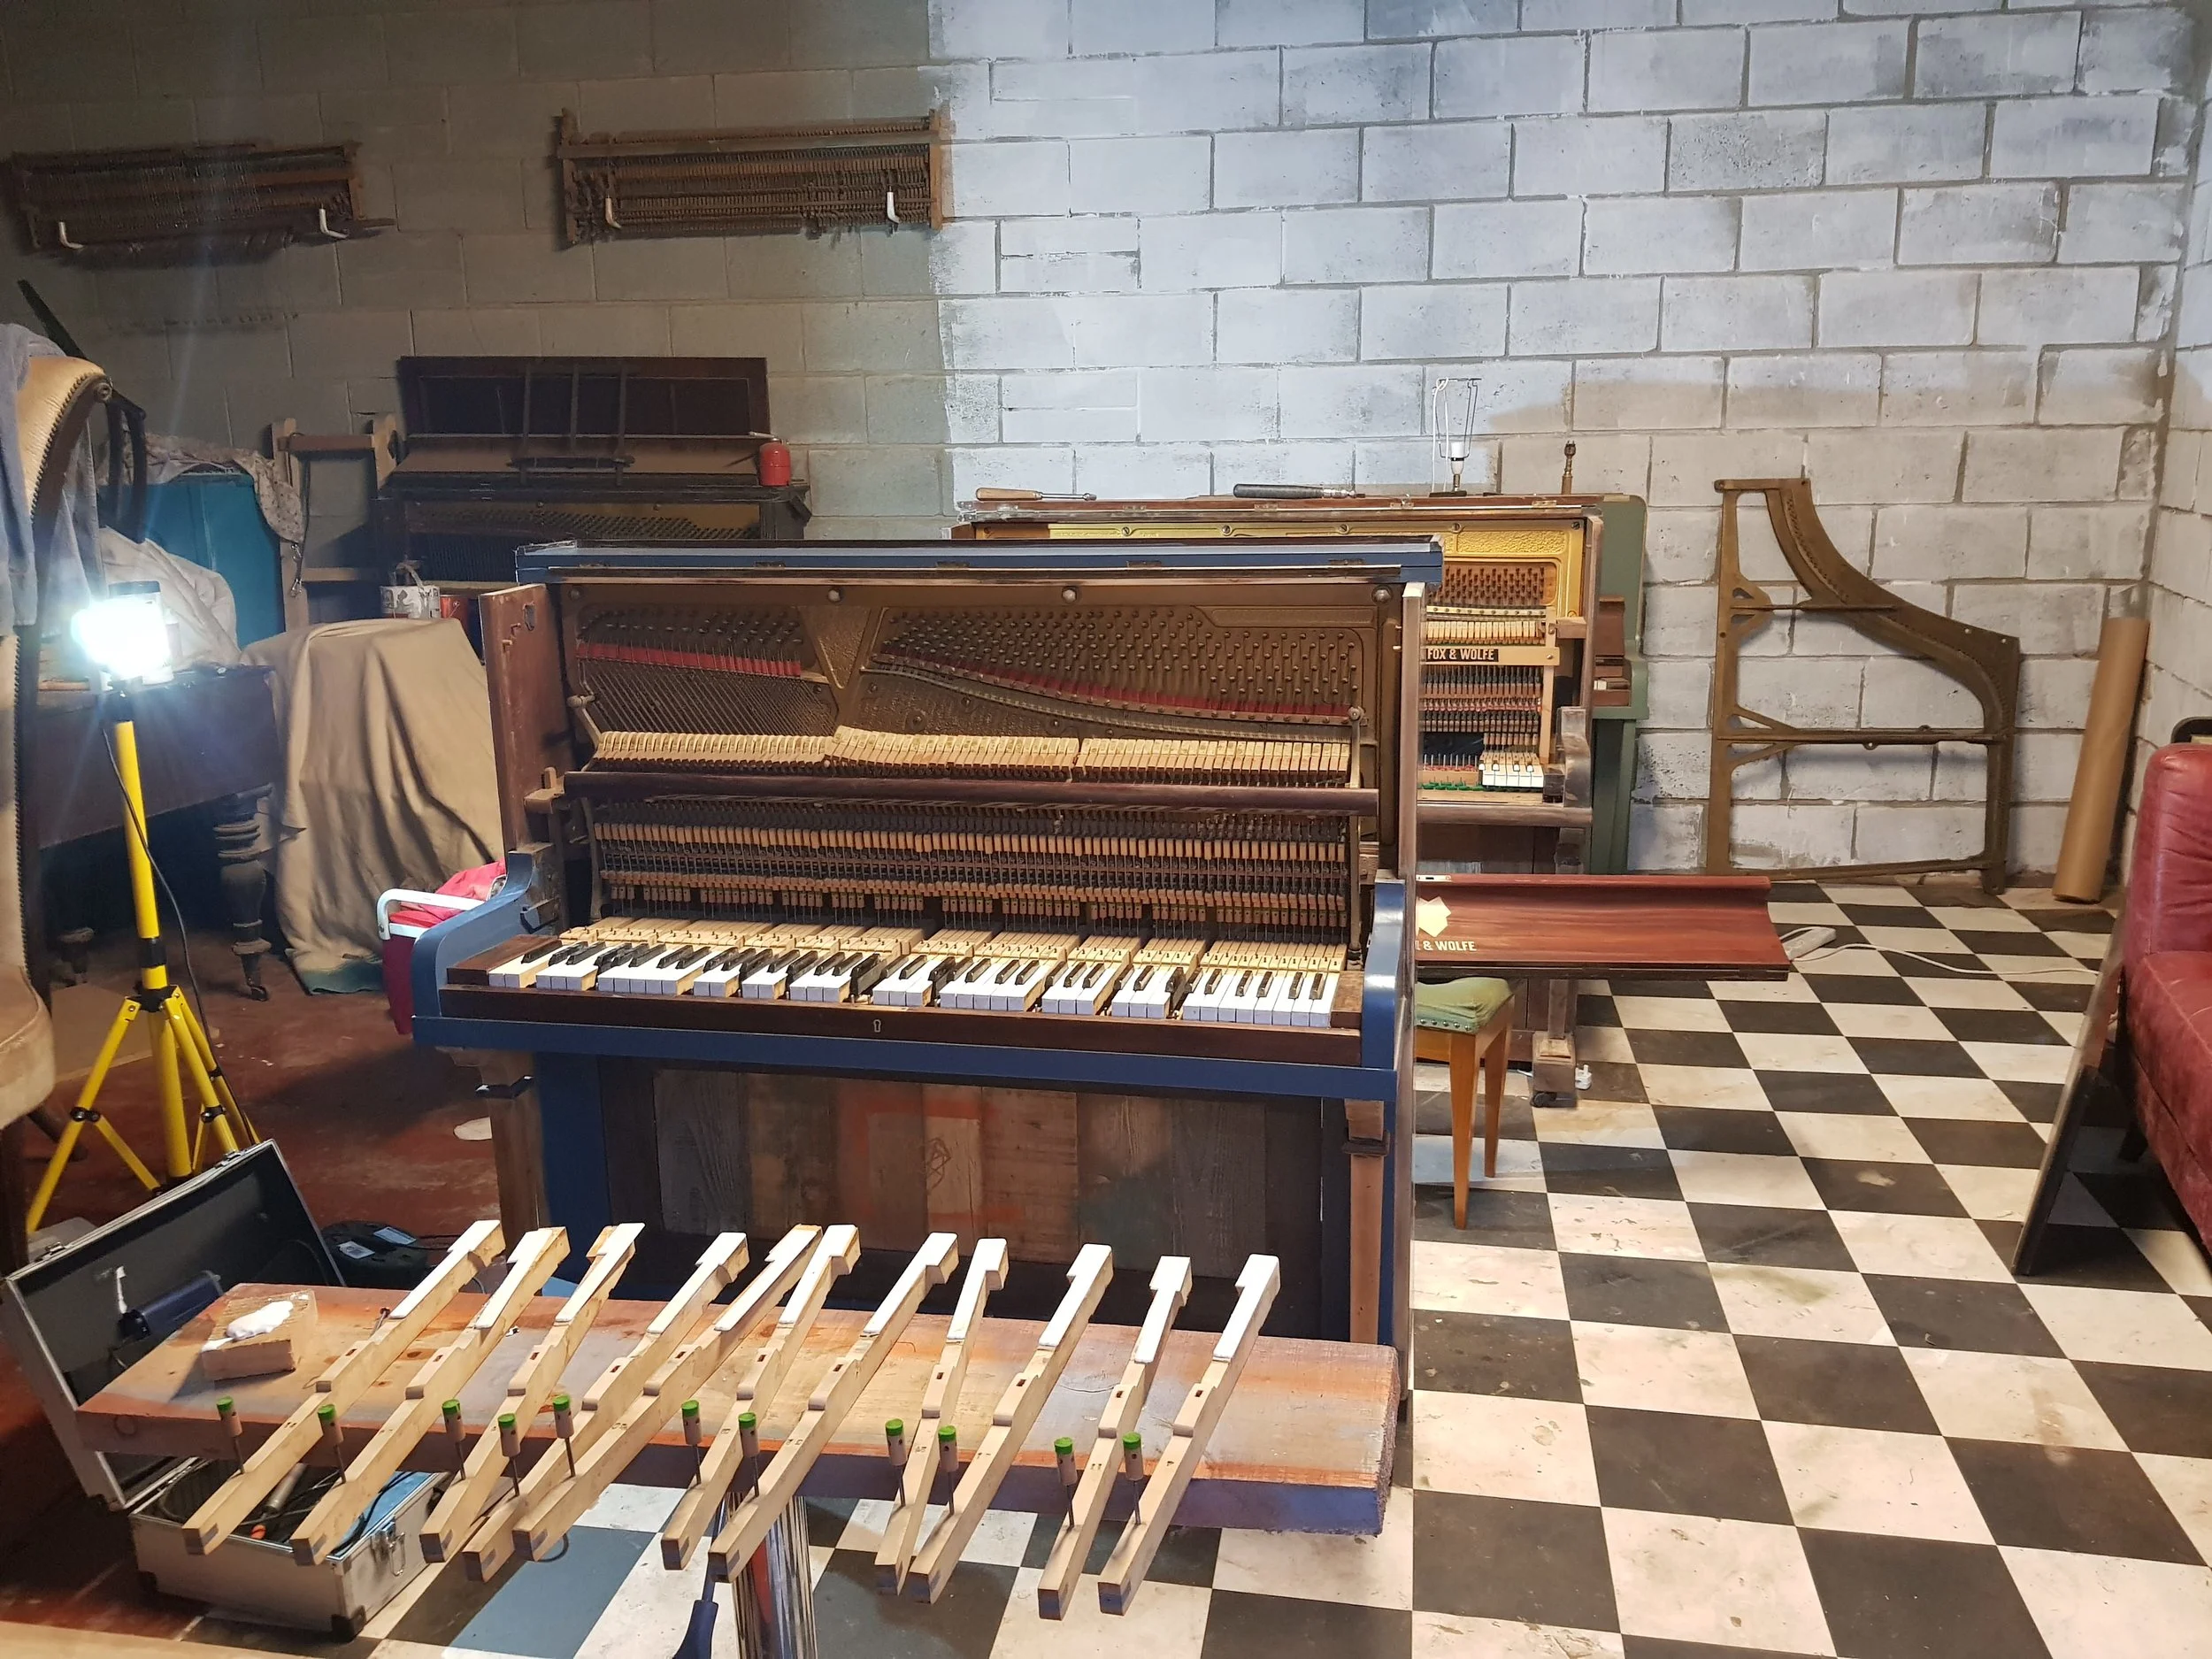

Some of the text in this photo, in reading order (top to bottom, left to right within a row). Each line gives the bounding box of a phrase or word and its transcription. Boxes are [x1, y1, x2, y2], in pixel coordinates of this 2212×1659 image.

[1427, 648, 1494, 661] FOX & WOLFE
[1422, 940, 1434, 951] &
[1434, 940, 1478, 952] WOLFE
